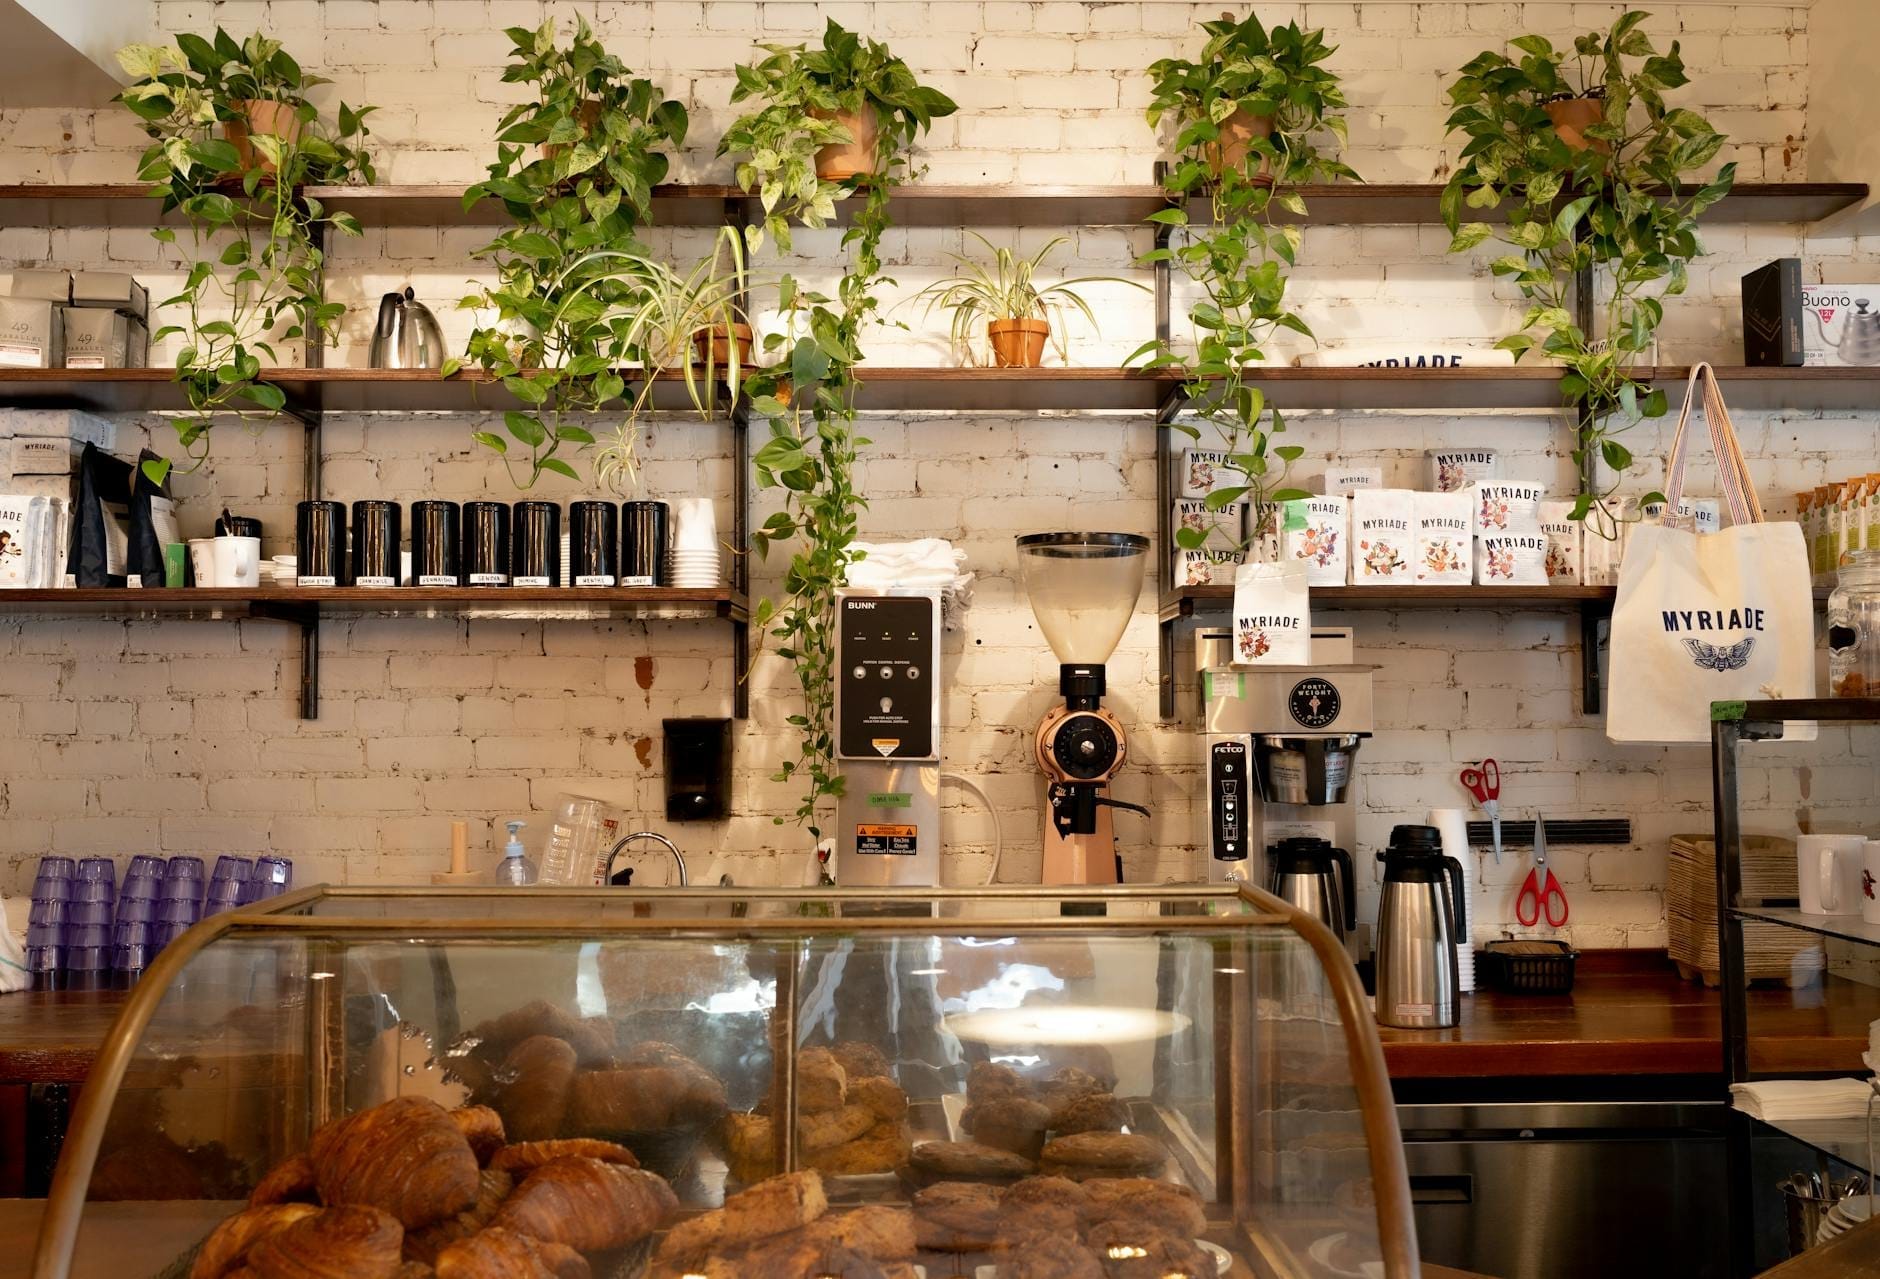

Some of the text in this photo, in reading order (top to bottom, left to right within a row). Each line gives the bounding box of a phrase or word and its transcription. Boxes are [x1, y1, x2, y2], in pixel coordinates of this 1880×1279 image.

[1802, 292, 1851, 307] Buono
[25, 443, 56, 451] MYRIADE
[1437, 453, 1493, 466] MYRIADE
[1340, 476, 1369, 484] MYRIADE
[1481, 487, 1541, 502] MYRIADE
[1306, 503, 1340, 515] YRIADE
[1363, 519, 1408, 531] MYRIADE
[1421, 518, 1466, 530] MYRIADE
[1485, 537, 1544, 551] MYRIADE
[848, 601, 876, 610] BUNN
[1239, 615, 1300, 630] MYRIADE
[1662, 606, 1764, 632] MYRIADE
